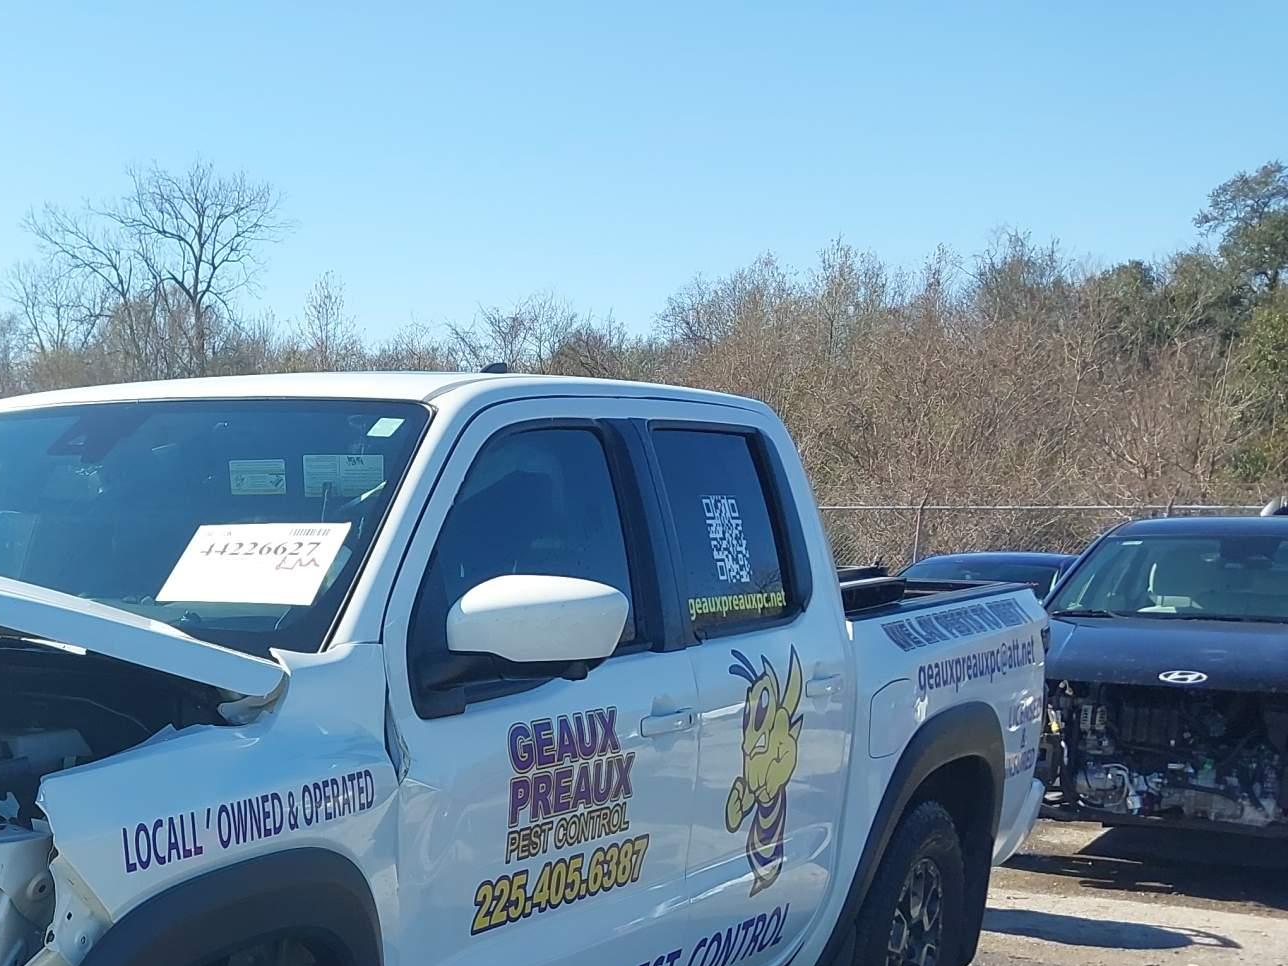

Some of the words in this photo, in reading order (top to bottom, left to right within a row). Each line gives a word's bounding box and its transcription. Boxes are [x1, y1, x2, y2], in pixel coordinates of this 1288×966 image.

[200, 541, 321, 556] 44226627
[688, 588, 786, 621] geauxpreauxpc.net
[918, 635, 1036, 698] geauxpreauxpc@att.net
[507, 706, 622, 773] GEAUX
[217, 792, 284, 849] OWNED
[287, 791, 299, 830] &
[301, 769, 375, 826] OPERATED
[508, 752, 636, 828] PREAUX
[505, 821, 553, 864] PEST
[553, 802, 630, 851] CONTROL
[470, 834, 650, 936] 225.405.6387
